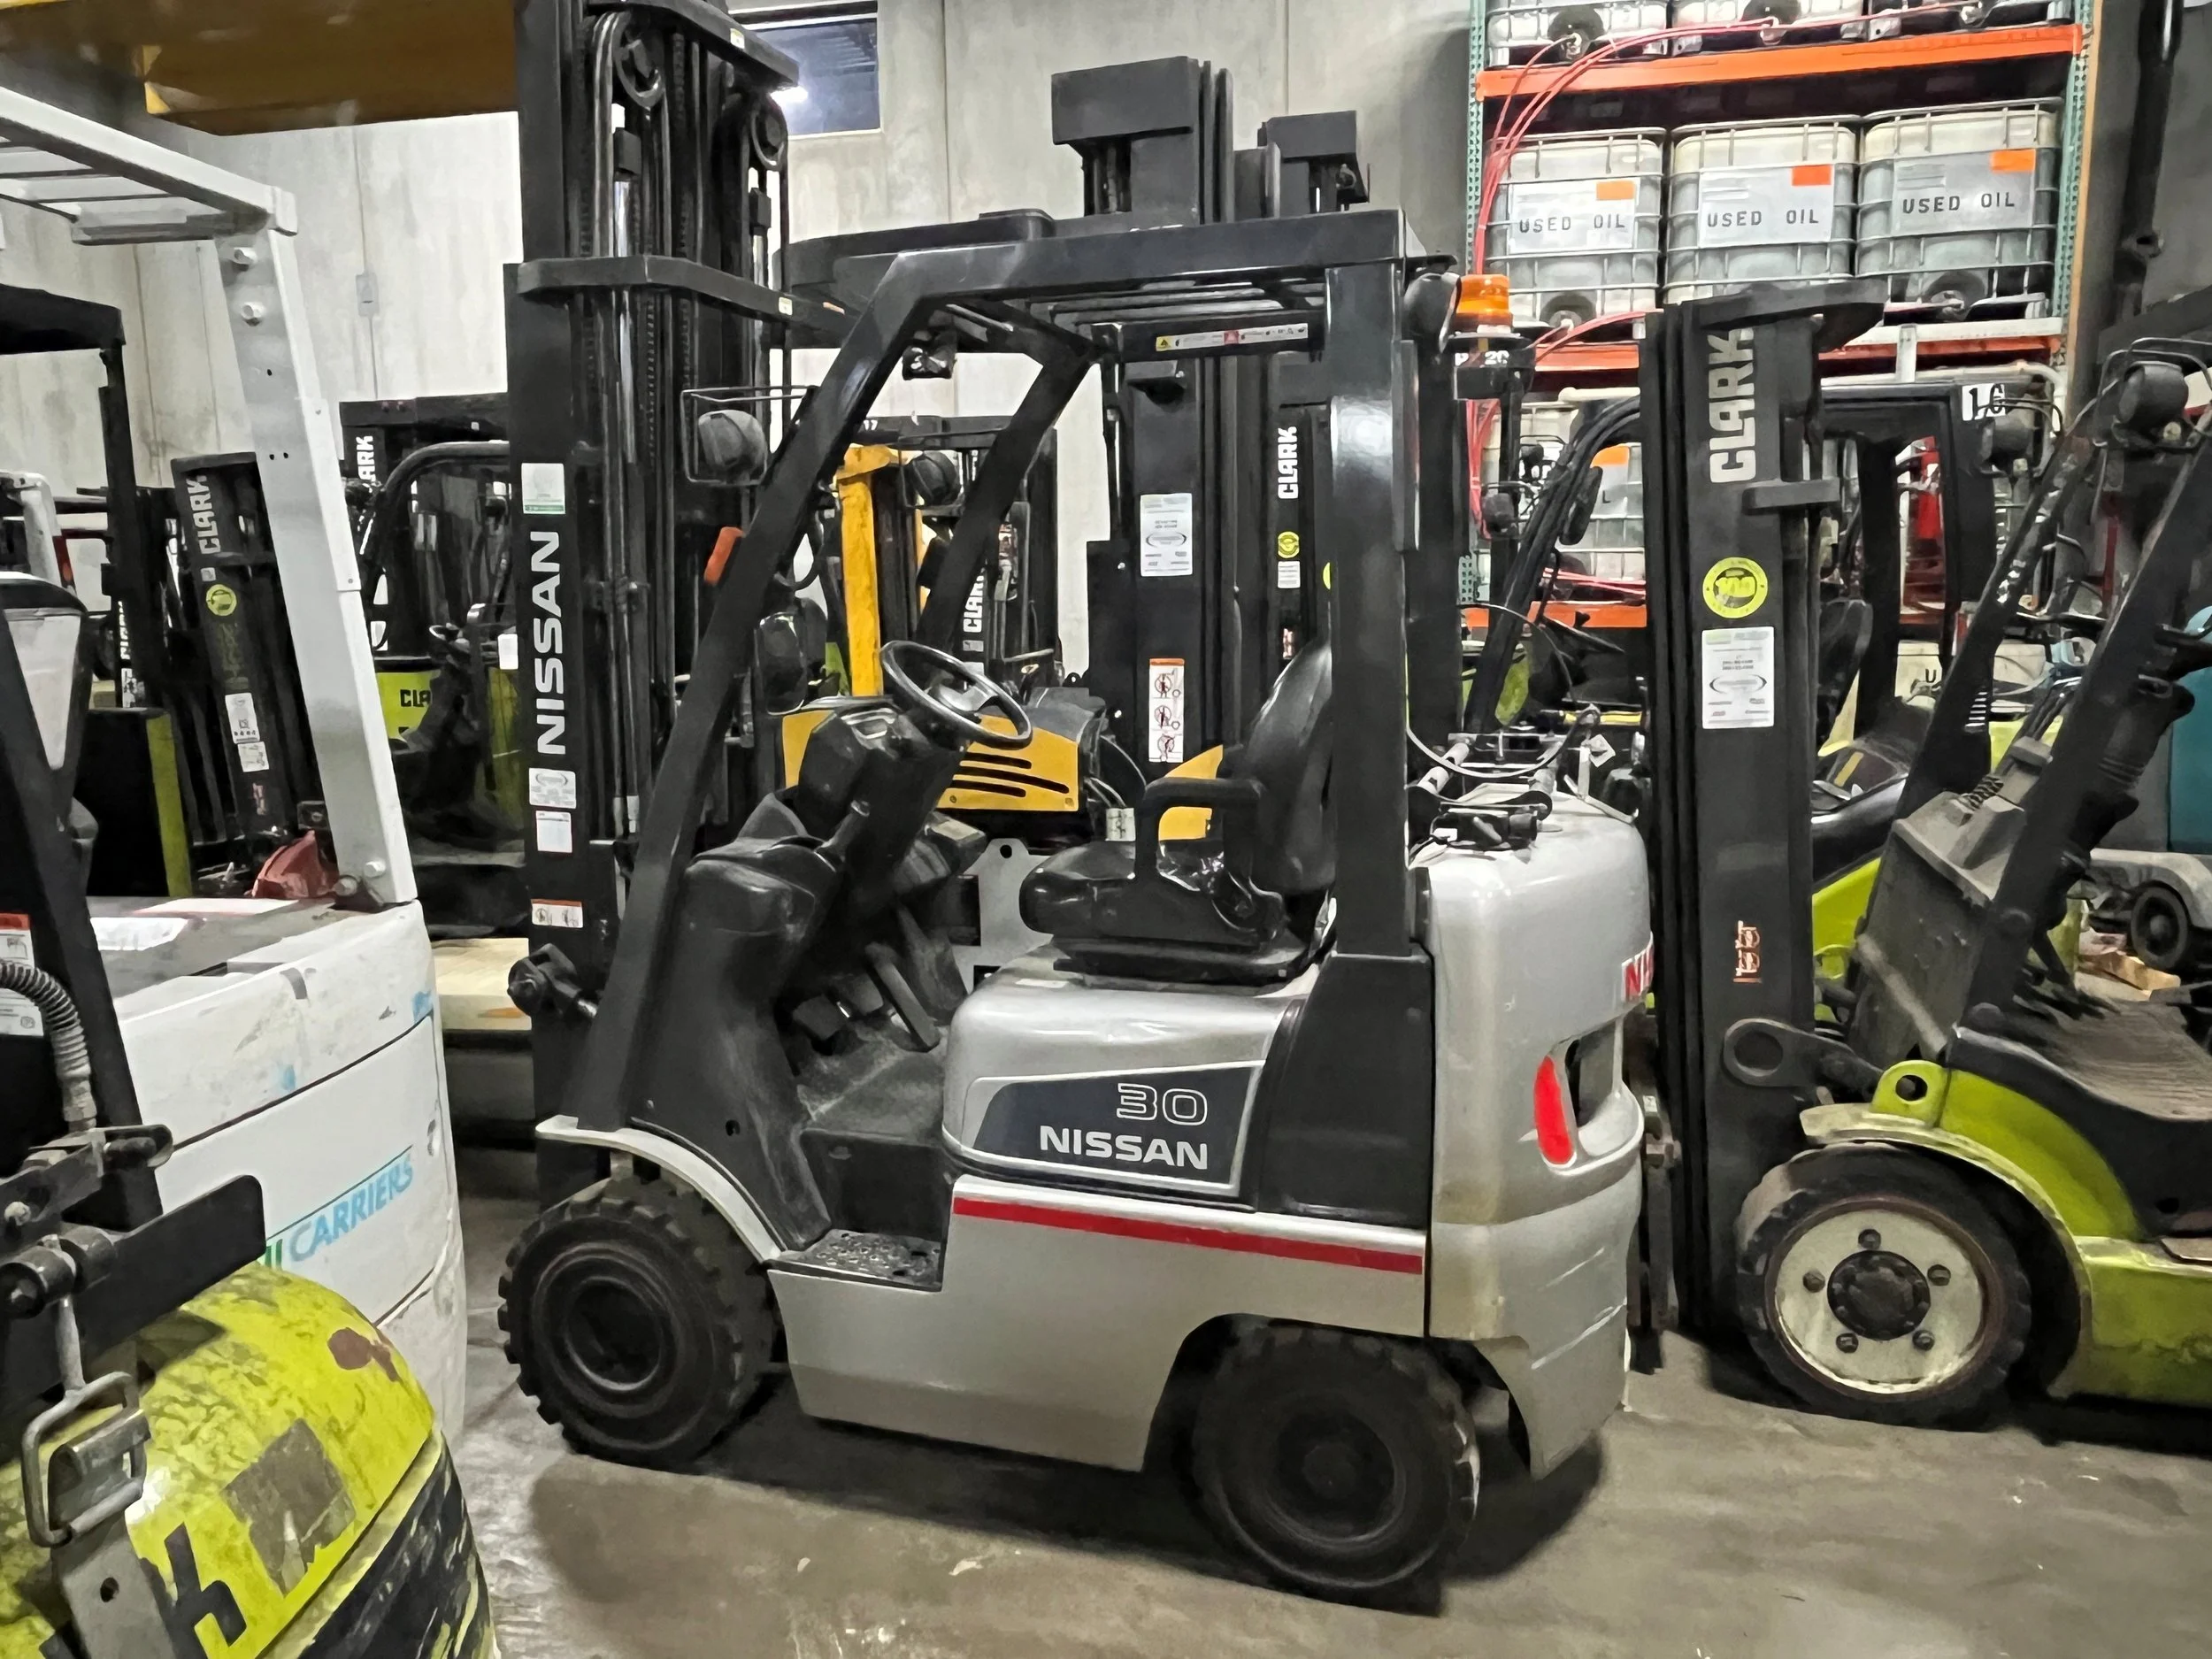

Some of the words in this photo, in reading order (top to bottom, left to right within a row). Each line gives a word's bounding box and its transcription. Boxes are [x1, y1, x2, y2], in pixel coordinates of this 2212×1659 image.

[1519, 215, 1571, 234] USED
[1594, 213, 1626, 229] OIL
[1707, 211, 1763, 227] USED
[1786, 209, 1819, 224] OIL
[1902, 196, 1961, 214] USED
[1980, 192, 2015, 208] OIL
[1707, 326, 1756, 483] CLARK
[1278, 426, 1299, 499] CLARK
[185, 474, 221, 555] CLARK
[530, 531, 566, 755] NISSAN
[1116, 1082, 1209, 1126] 30
[1040, 1125, 1208, 1170] NISSAN
[289, 1153, 413, 1263] CARRIERS
